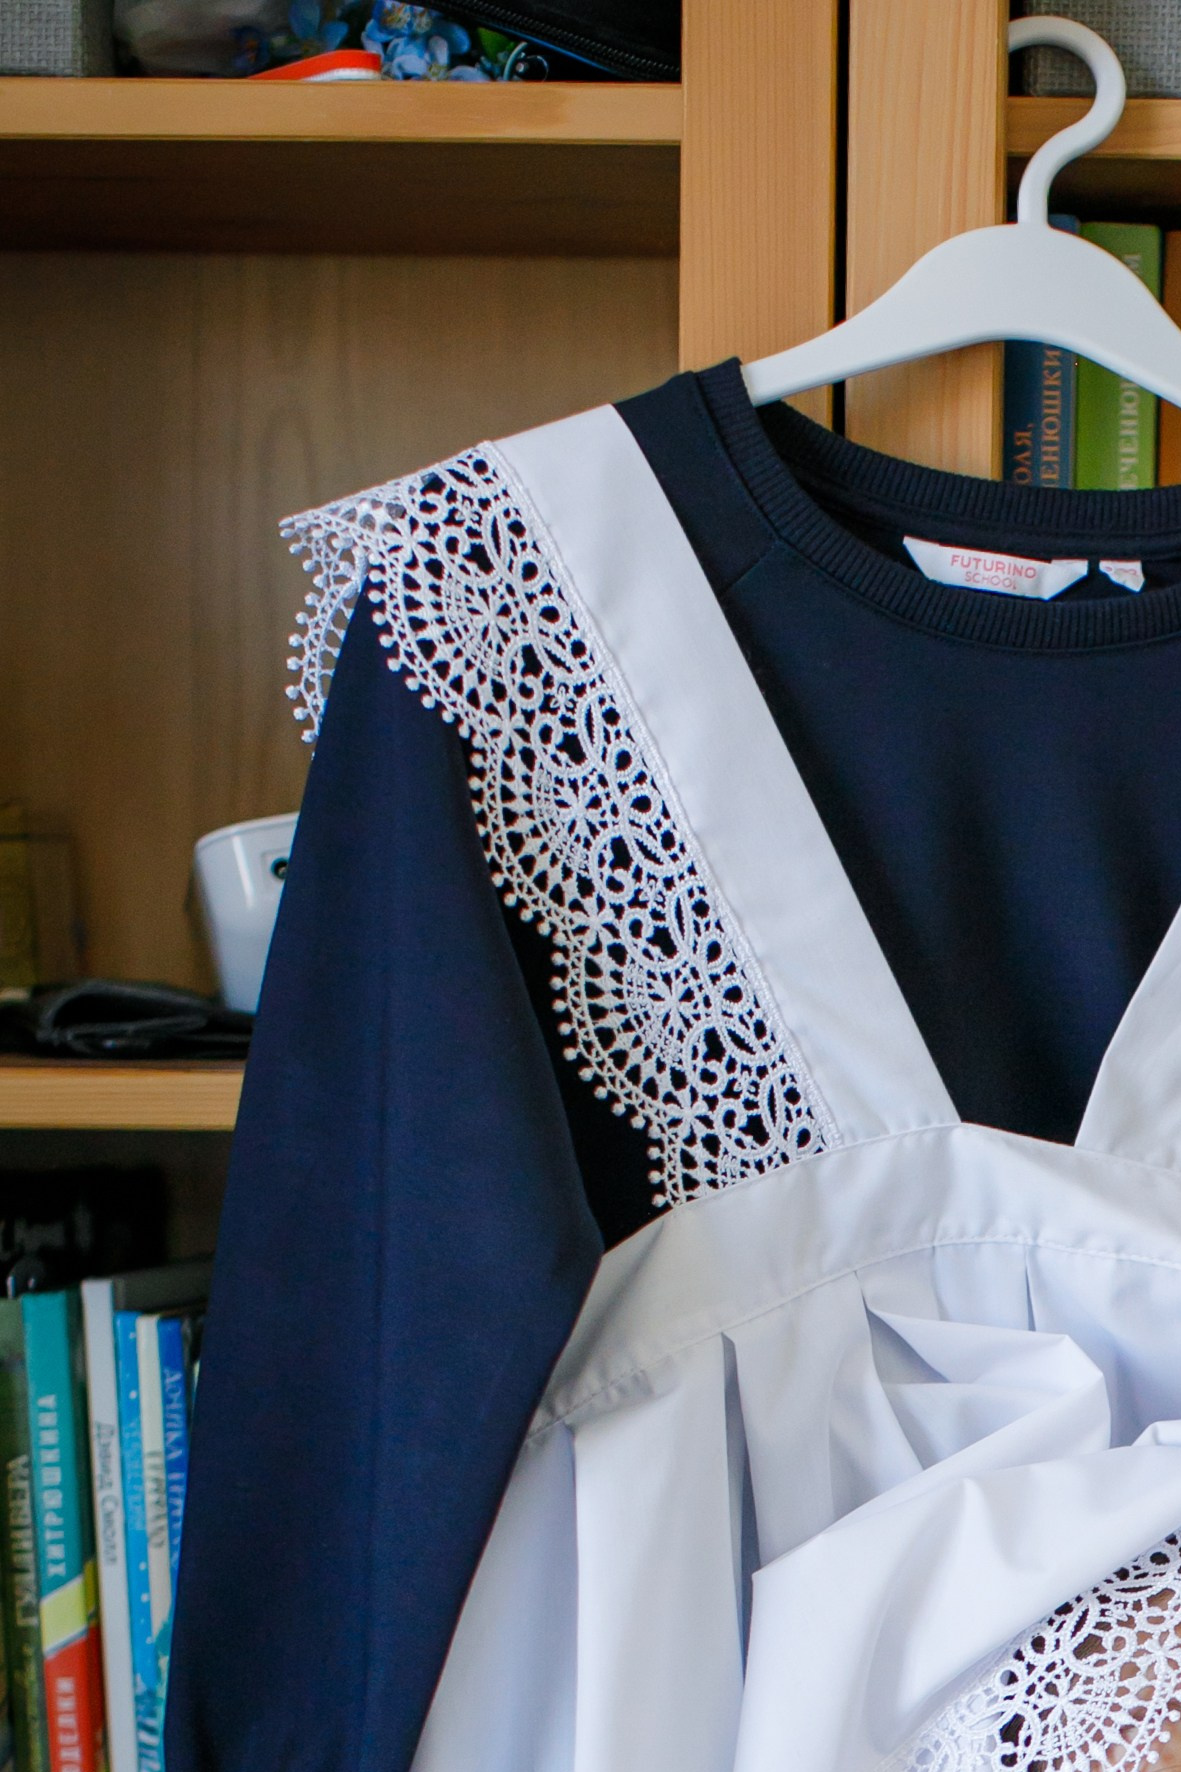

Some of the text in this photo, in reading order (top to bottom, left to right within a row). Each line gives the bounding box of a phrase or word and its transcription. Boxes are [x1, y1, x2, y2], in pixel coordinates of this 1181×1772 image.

[1040, 346, 1062, 488] ЕНЮШКИ
[950, 554, 1038, 580] FUTURINO
[964, 570, 1017, 590] SCHOOL
[38, 1394, 66, 1577] ХИТРЮШКИНА
